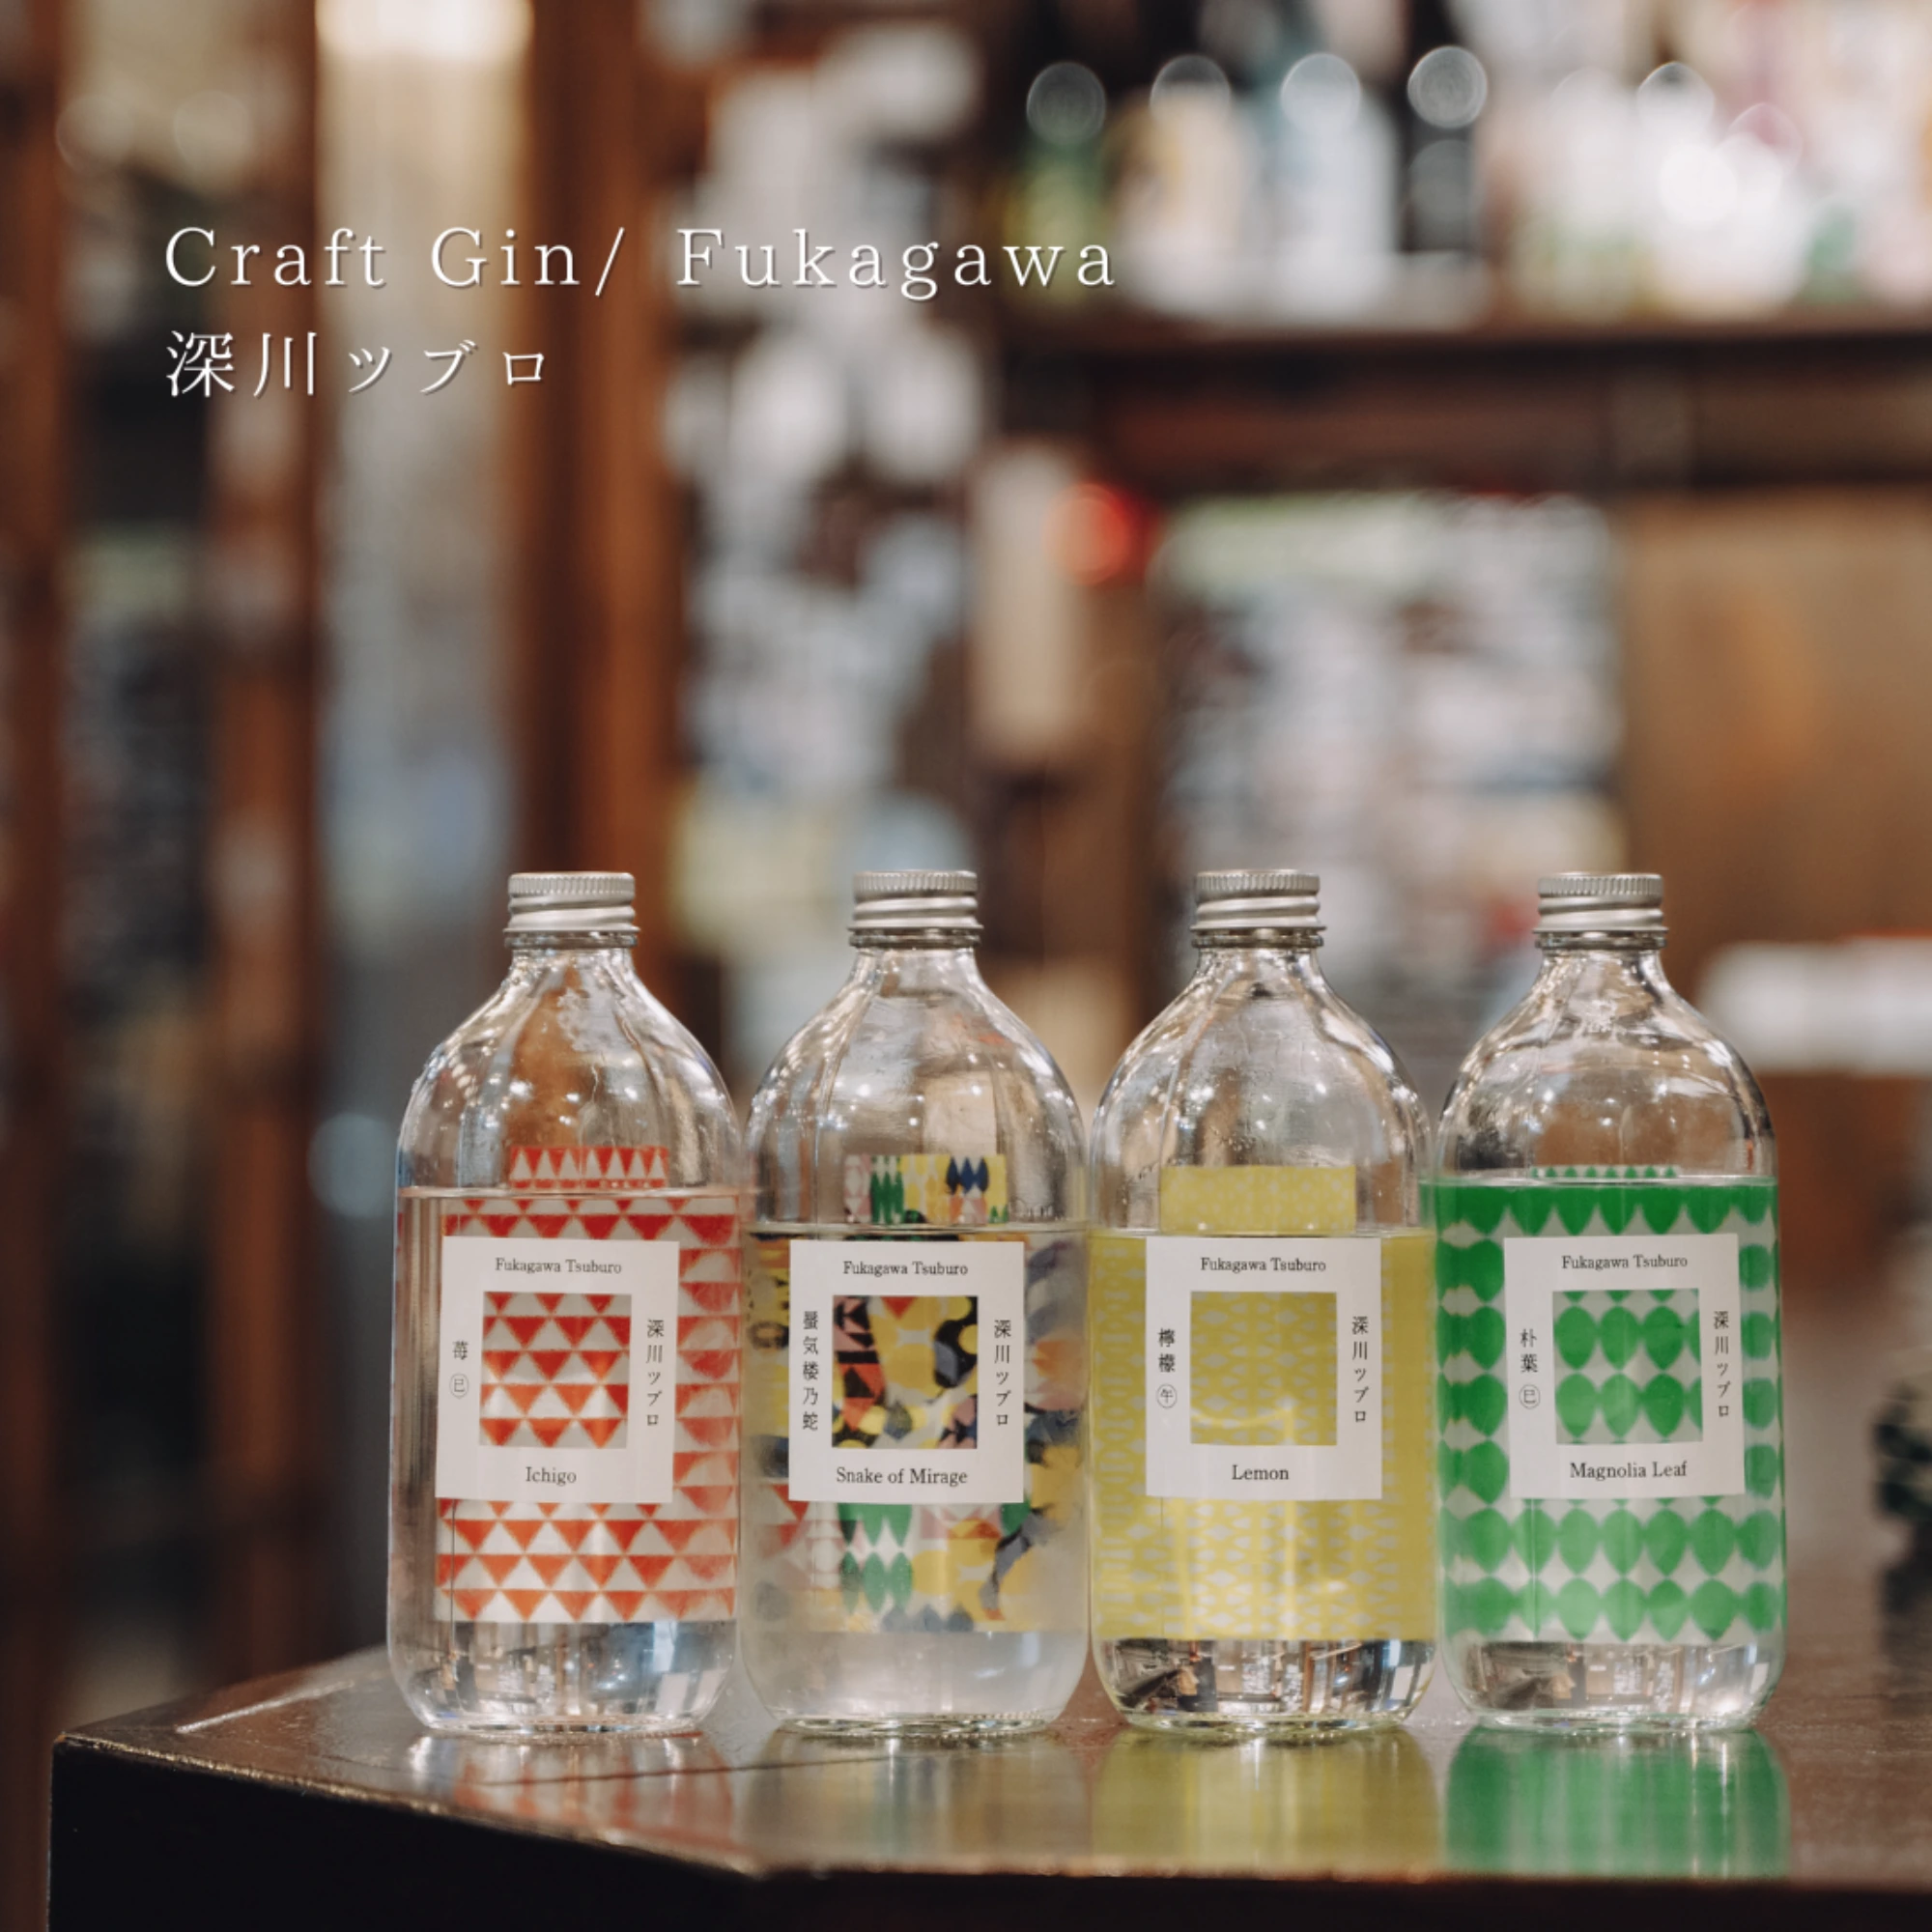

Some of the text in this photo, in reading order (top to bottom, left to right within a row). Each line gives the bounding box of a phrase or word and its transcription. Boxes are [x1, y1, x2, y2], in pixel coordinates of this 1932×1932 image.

[495, 1257, 623, 1275] Fukagawa Tsuburo
[842, 1260, 970, 1279] Fukagawa Tsuburo
[1200, 1256, 1327, 1275] Fukagawa Tsuburo
[1561, 1253, 1689, 1272] Fukagawa Tsuburo
[645, 1319, 665, 1427] 深川ツブロ
[993, 1319, 1013, 1427] 深川ツブロ
[1351, 1315, 1371, 1424] 深川ツブロ
[1713, 1310, 1732, 1418] 深川ツブロ
[525, 1465, 578, 1488] Ichigo
[836, 1465, 969, 1489] Snake of Mirage
[1231, 1463, 1291, 1482] Lemon
[1569, 1459, 1688, 1483] Magnolia Leaf
